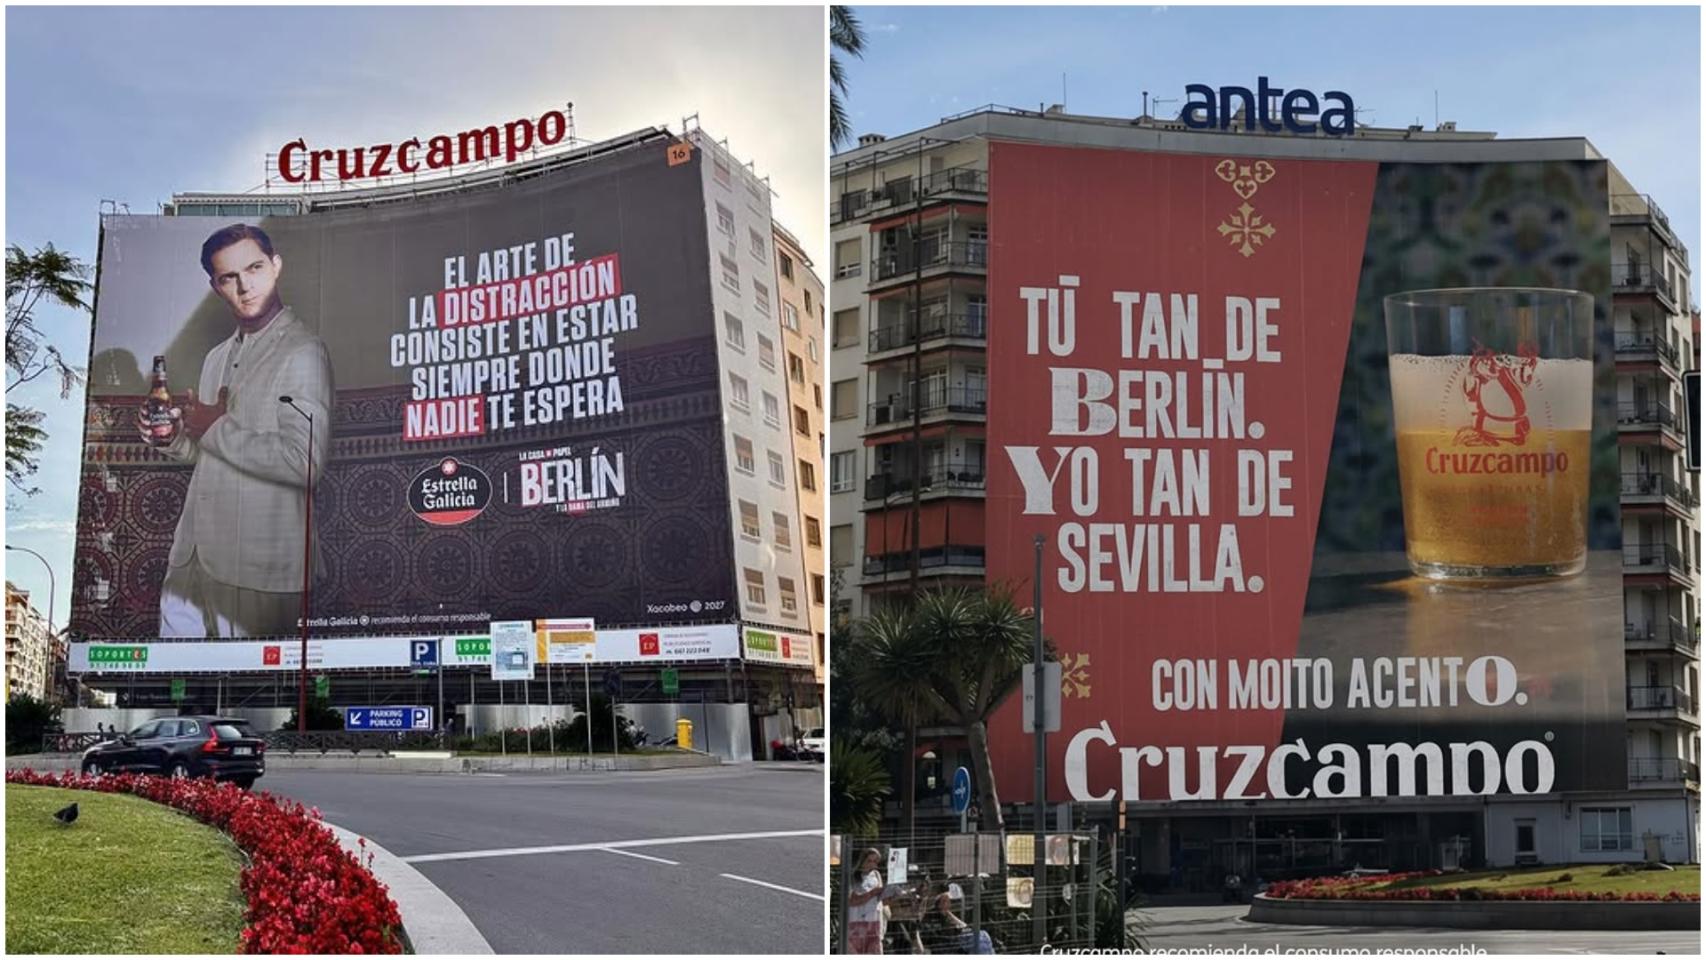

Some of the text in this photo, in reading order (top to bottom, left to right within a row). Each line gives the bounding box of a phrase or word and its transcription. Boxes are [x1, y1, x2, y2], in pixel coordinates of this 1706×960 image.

[1181, 76, 1355, 136] antea
[278, 110, 567, 183] Cruzcampo
[672, 148, 686, 160] 16
[445, 232, 575, 289] EL ARTE DE
[409, 260, 615, 330] LA DISTRACCIÓN
[390, 294, 639, 367] CONSISTE EN ESTAR
[1113, 291, 1199, 360] TAN
[1225, 296, 1282, 362] DE
[412, 337, 616, 401] SIEMPRE DONDE
[407, 375, 624, 438] NADIE TE ESPERA
[421, 477, 478, 494] Estrella
[520, 446, 625, 507] BERLÍN
[1004, 446, 1294, 517] YO TAN DE
[1425, 447, 1569, 478] Cruzcampo
[422, 491, 475, 510] Galicia
[1057, 522, 1264, 593] SEVILLA.
[297, 617, 328, 628] Etrella
[646, 601, 725, 614] Xacobeo 2027
[415, 642, 429, 661] P
[1151, 655, 1529, 711] CON MOITO ACENTO.
[370, 710, 403, 718] PARKING
[1064, 720, 1556, 802] Cruzcampo
